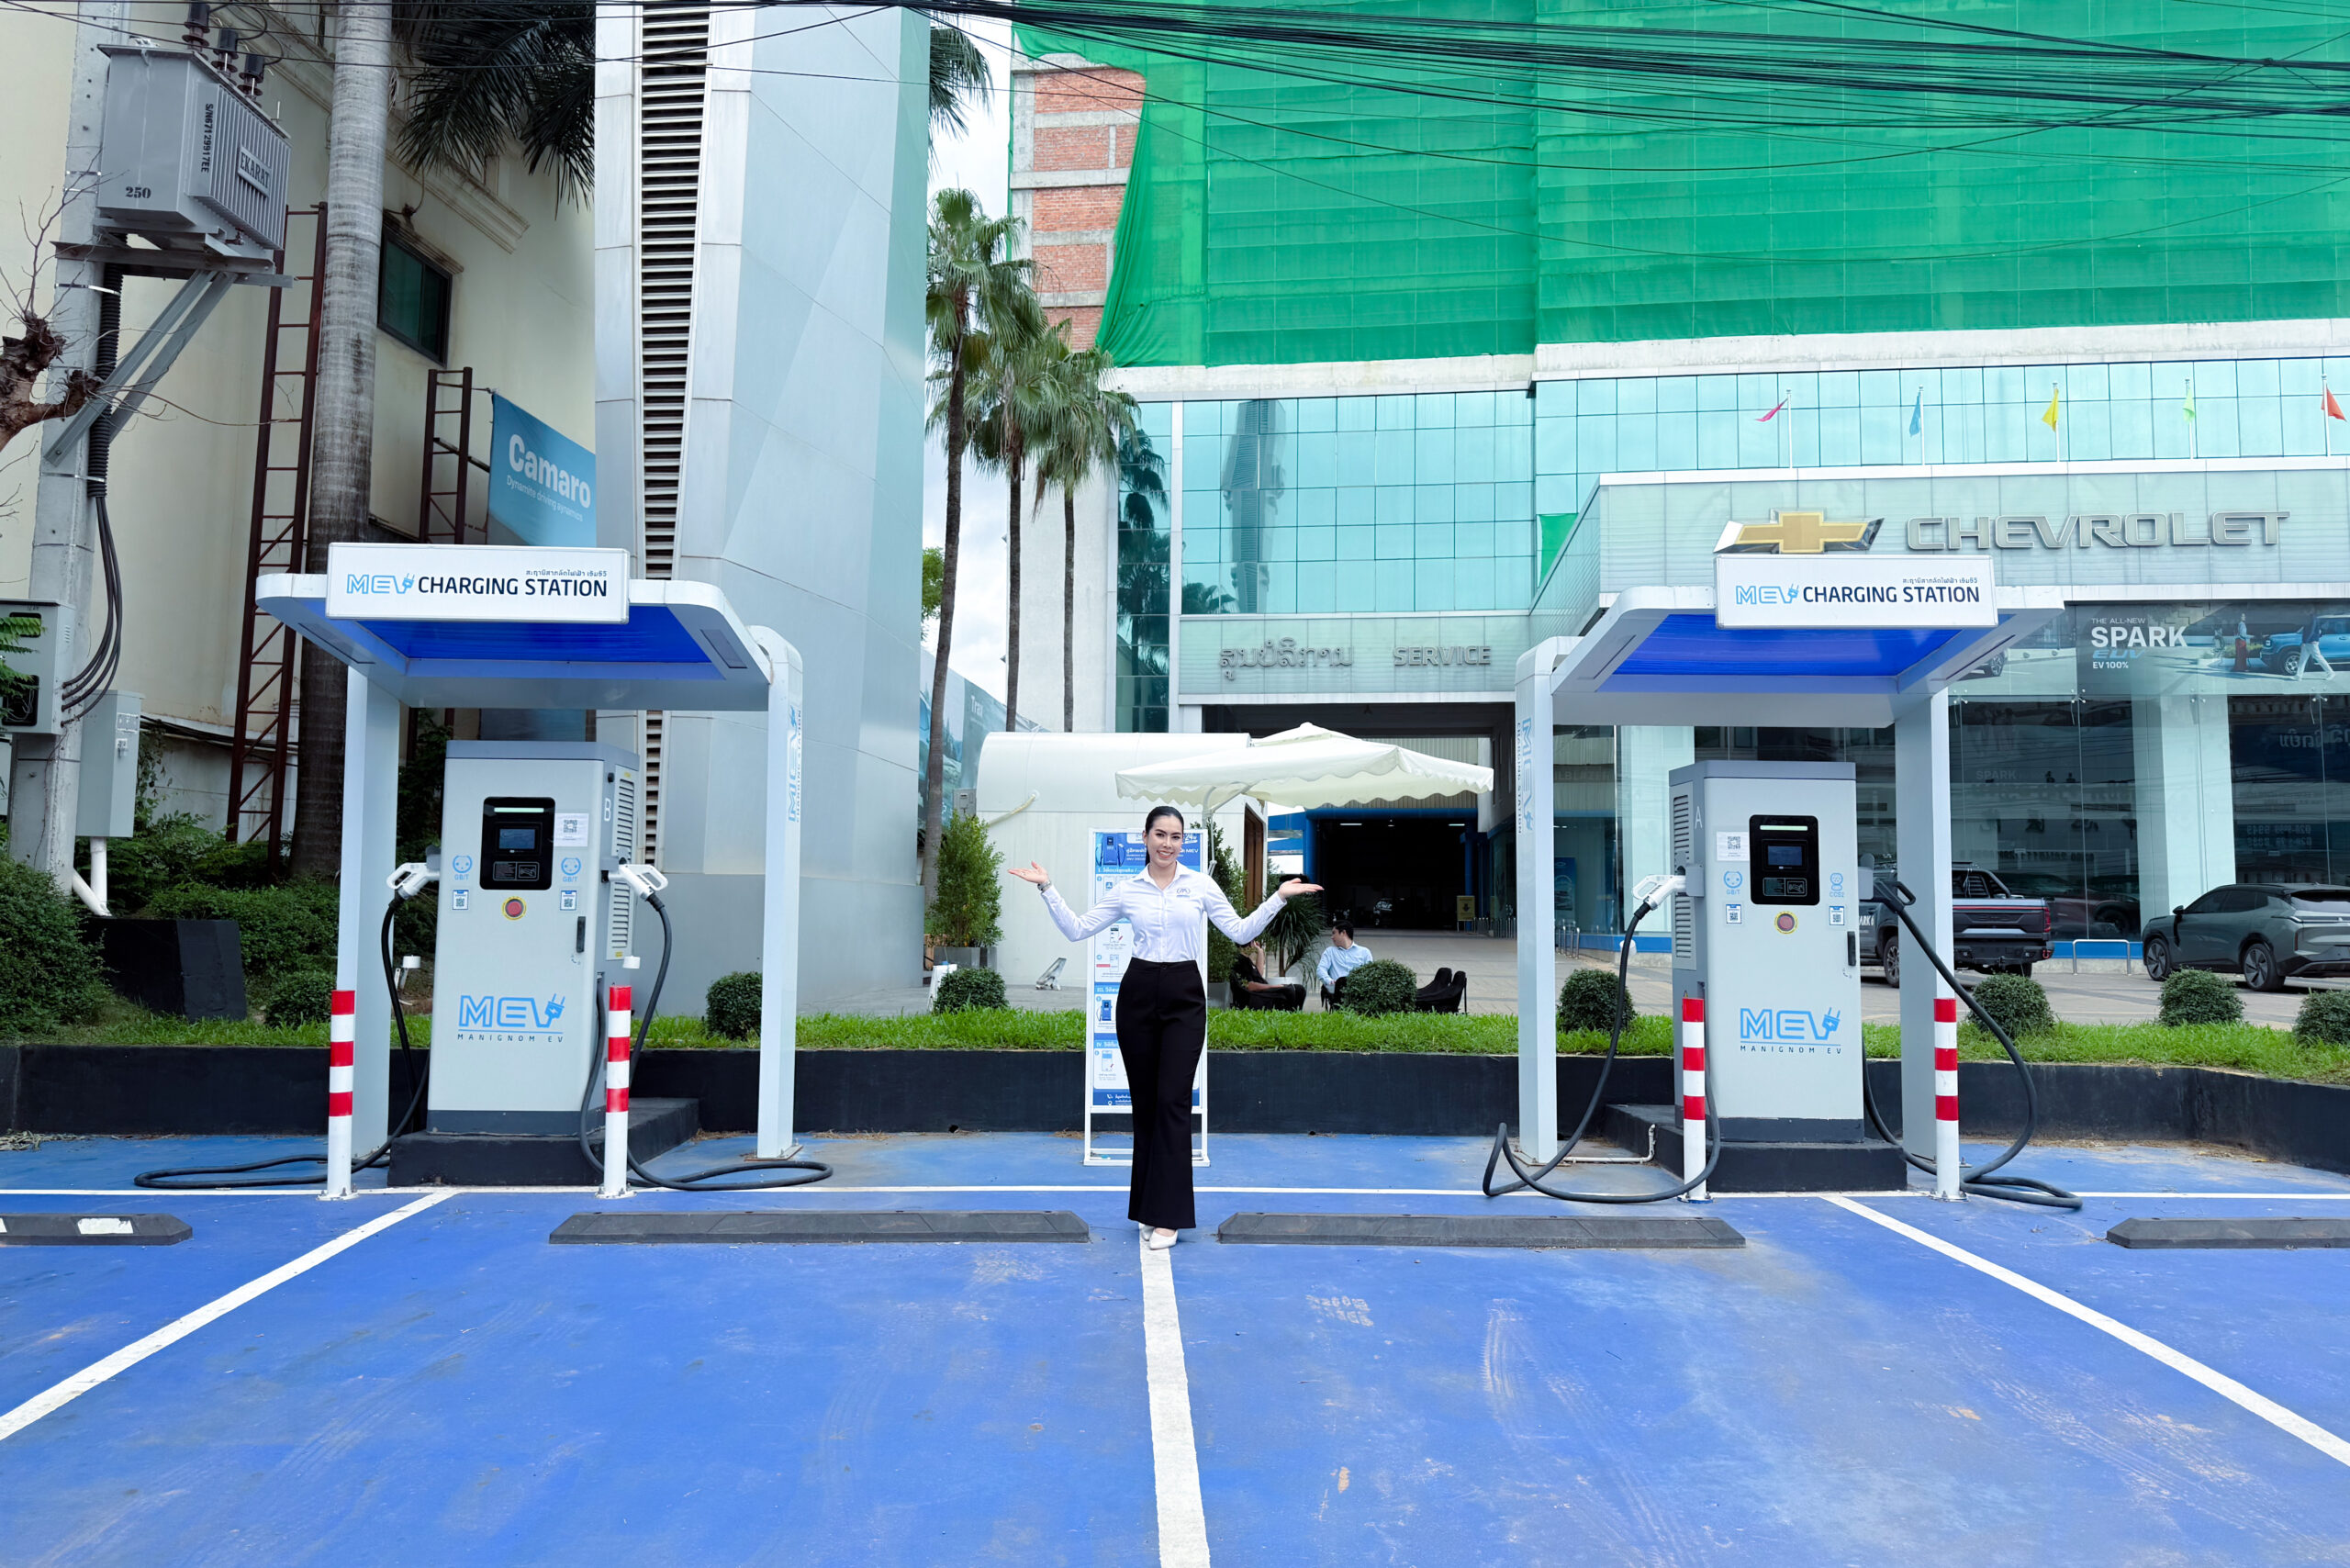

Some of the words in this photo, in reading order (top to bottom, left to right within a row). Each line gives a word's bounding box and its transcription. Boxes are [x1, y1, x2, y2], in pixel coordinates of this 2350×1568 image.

[201, 103, 214, 174] S/N67129917EE
[241, 151, 270, 189] EKARAT
[125, 186, 151, 199] 250
[509, 433, 591, 509] Camaro
[1907, 510, 2292, 551] CHEVROLET
[346, 573, 415, 596] MEV
[418, 576, 519, 596] CHARGING
[524, 577, 608, 597] STATION
[1736, 583, 1799, 605] MEV
[1803, 586, 1897, 603] CHARGING
[1902, 586, 1980, 603] STATION
[2090, 626, 2188, 648] SPARK
[1393, 645, 1492, 666] SERVICE
[2092, 649, 2146, 659] EUV
[2092, 661, 2105, 669] EV
[2105, 661, 2130, 669] 100%
[603, 798, 612, 822] B
[1695, 805, 1703, 830] A
[562, 875, 578, 883] GB/T
[1859, 915, 1871, 926] ARK
[458, 993, 565, 1029] MEV
[1740, 1006, 1841, 1041] MEV
[457, 1033, 535, 1043] MANIGNOM
[547, 1035, 564, 1043] EV
[1740, 1045, 1815, 1054] MANIGNOM
[1827, 1047, 1841, 1055] EV
